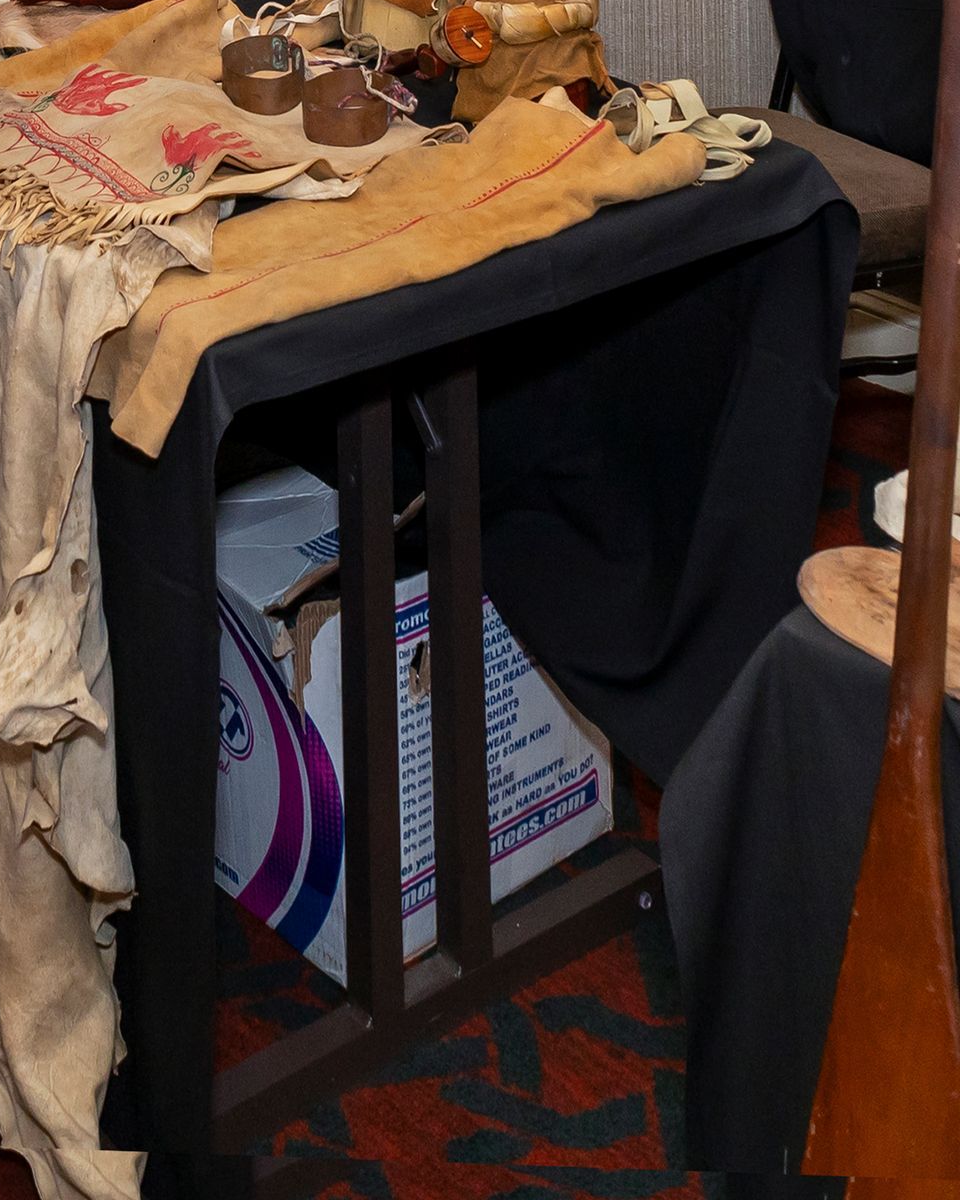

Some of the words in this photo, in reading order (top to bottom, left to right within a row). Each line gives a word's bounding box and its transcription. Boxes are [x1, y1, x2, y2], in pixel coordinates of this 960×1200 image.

[487, 697, 520, 722] SHIRTS
[488, 750, 500, 765] OF
[503, 735, 528, 757] SOME
[529, 723, 551, 743] KIND
[501, 756, 565, 801] INSTRUMENTS
[515, 787, 542, 810] HARD
[558, 767, 577, 786] YOU
[580, 753, 594, 773] DO?
